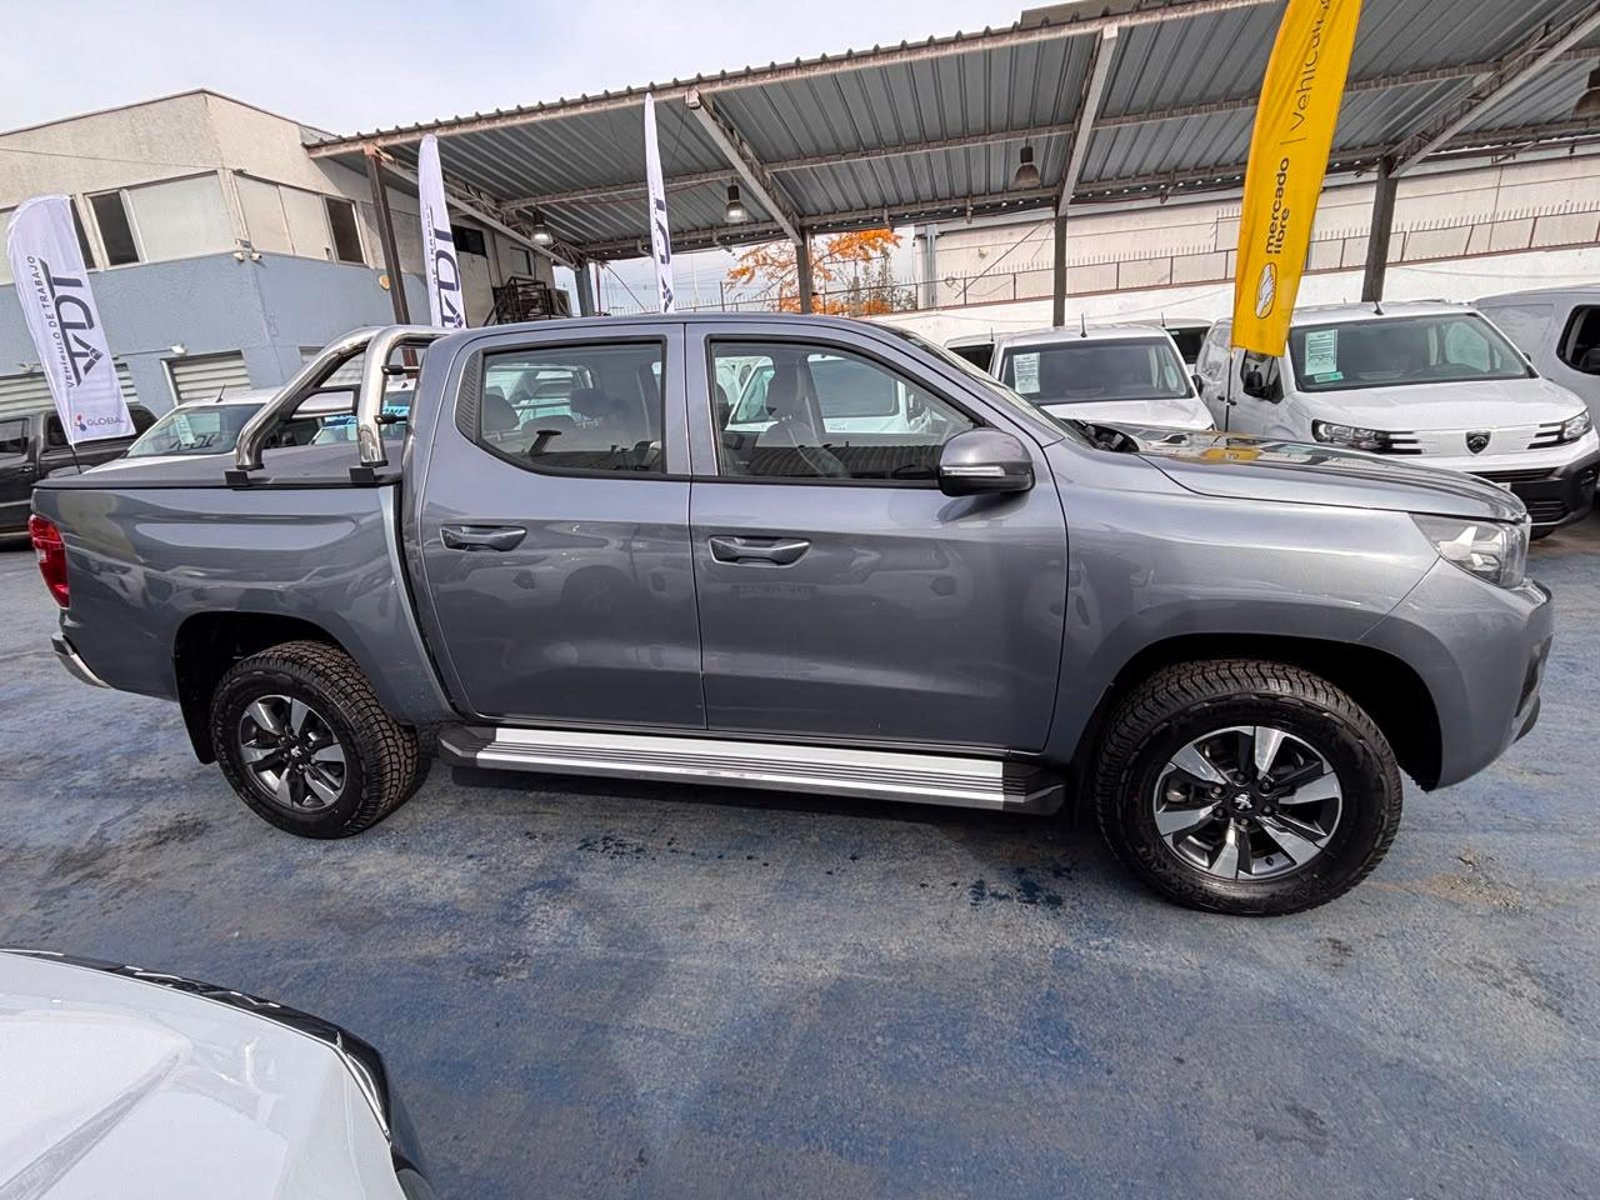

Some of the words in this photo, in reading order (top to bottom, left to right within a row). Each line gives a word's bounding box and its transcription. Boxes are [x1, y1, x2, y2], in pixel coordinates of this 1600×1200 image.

[1266, 157, 1290, 254] mercado
[1274, 207, 1290, 254] libre
[26, 255, 51, 309] TRABAJO
[45, 313, 58, 328] DE
